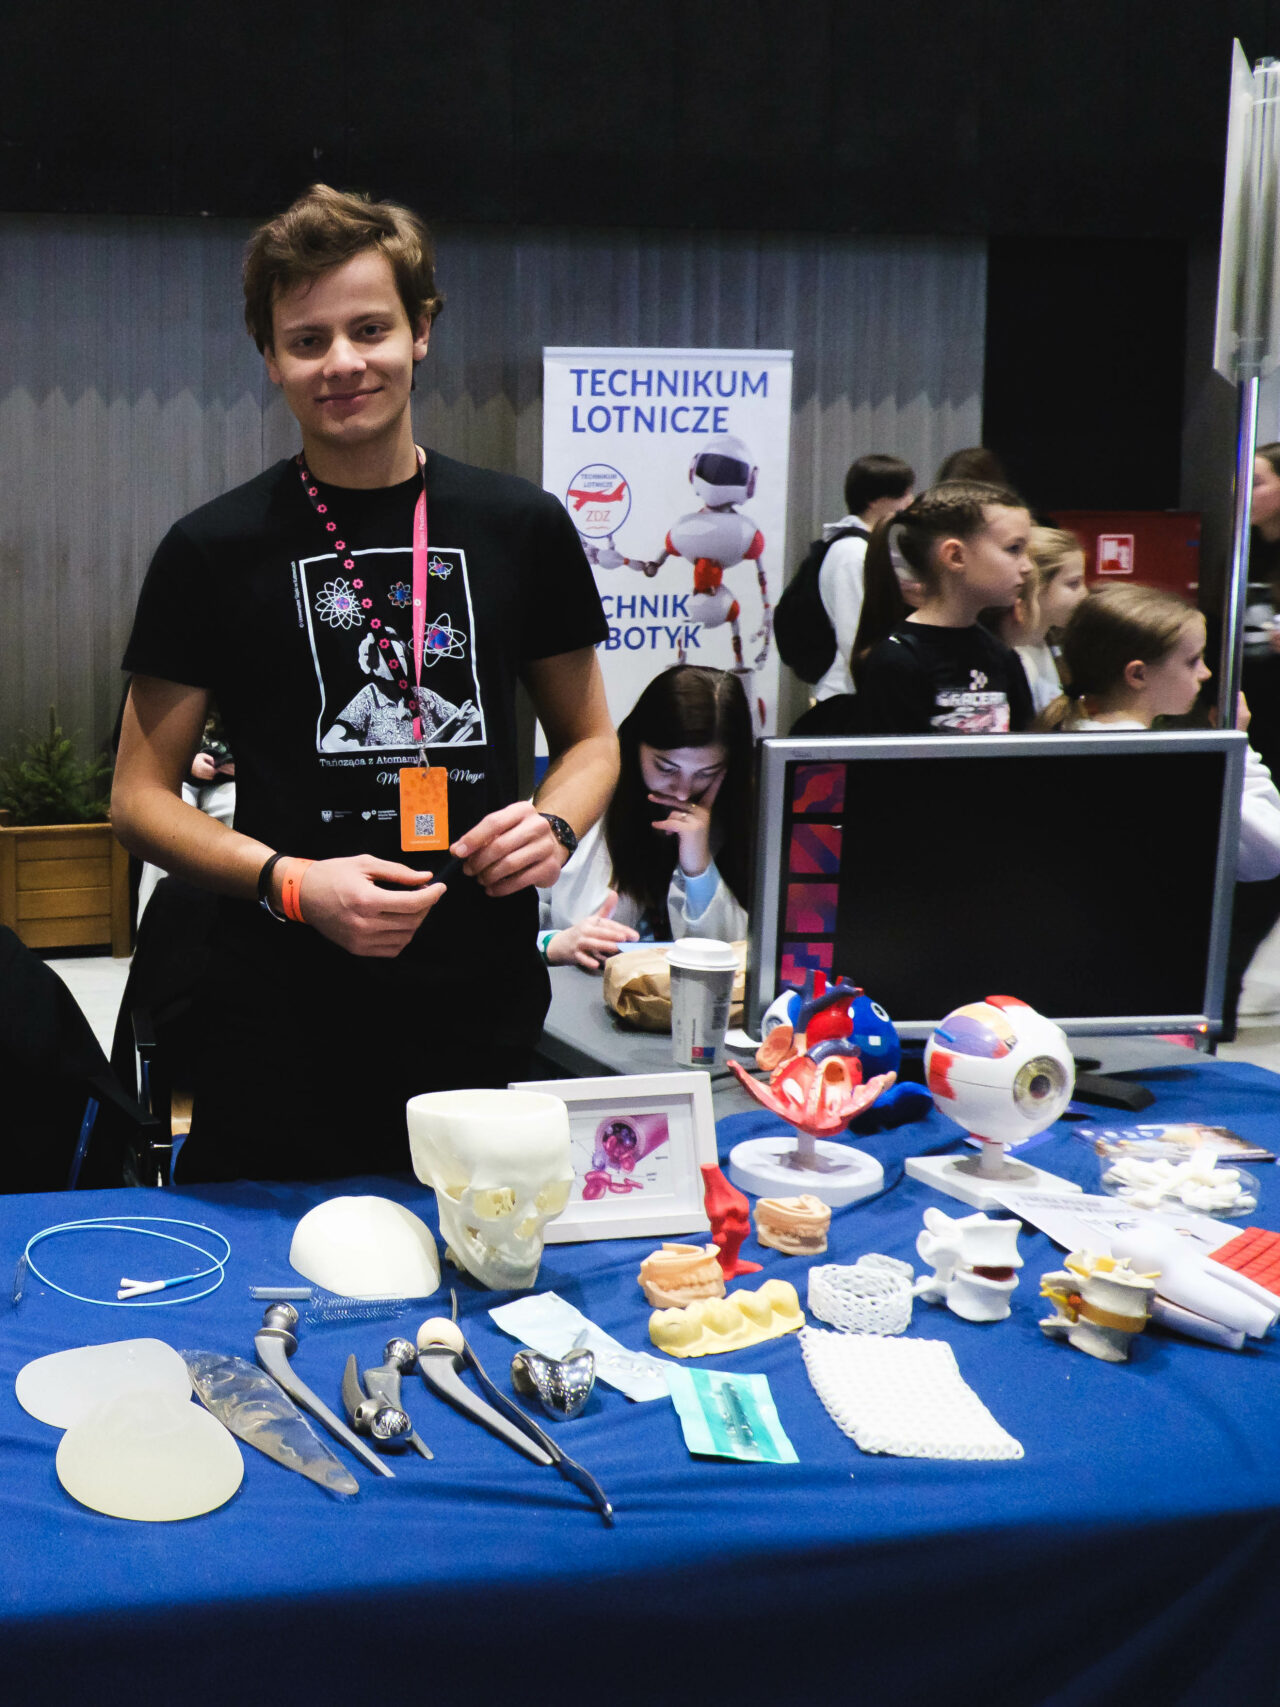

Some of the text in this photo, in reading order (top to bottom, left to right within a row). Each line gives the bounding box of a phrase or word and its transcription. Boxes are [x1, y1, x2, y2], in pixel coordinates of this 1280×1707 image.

[570, 369, 769, 398] TECHNIKUM
[571, 405, 729, 433] LOTNICZE
[585, 510, 611, 522] ZDZ
[602, 594, 690, 619] CHNIK
[594, 625, 702, 651] BOTYK
